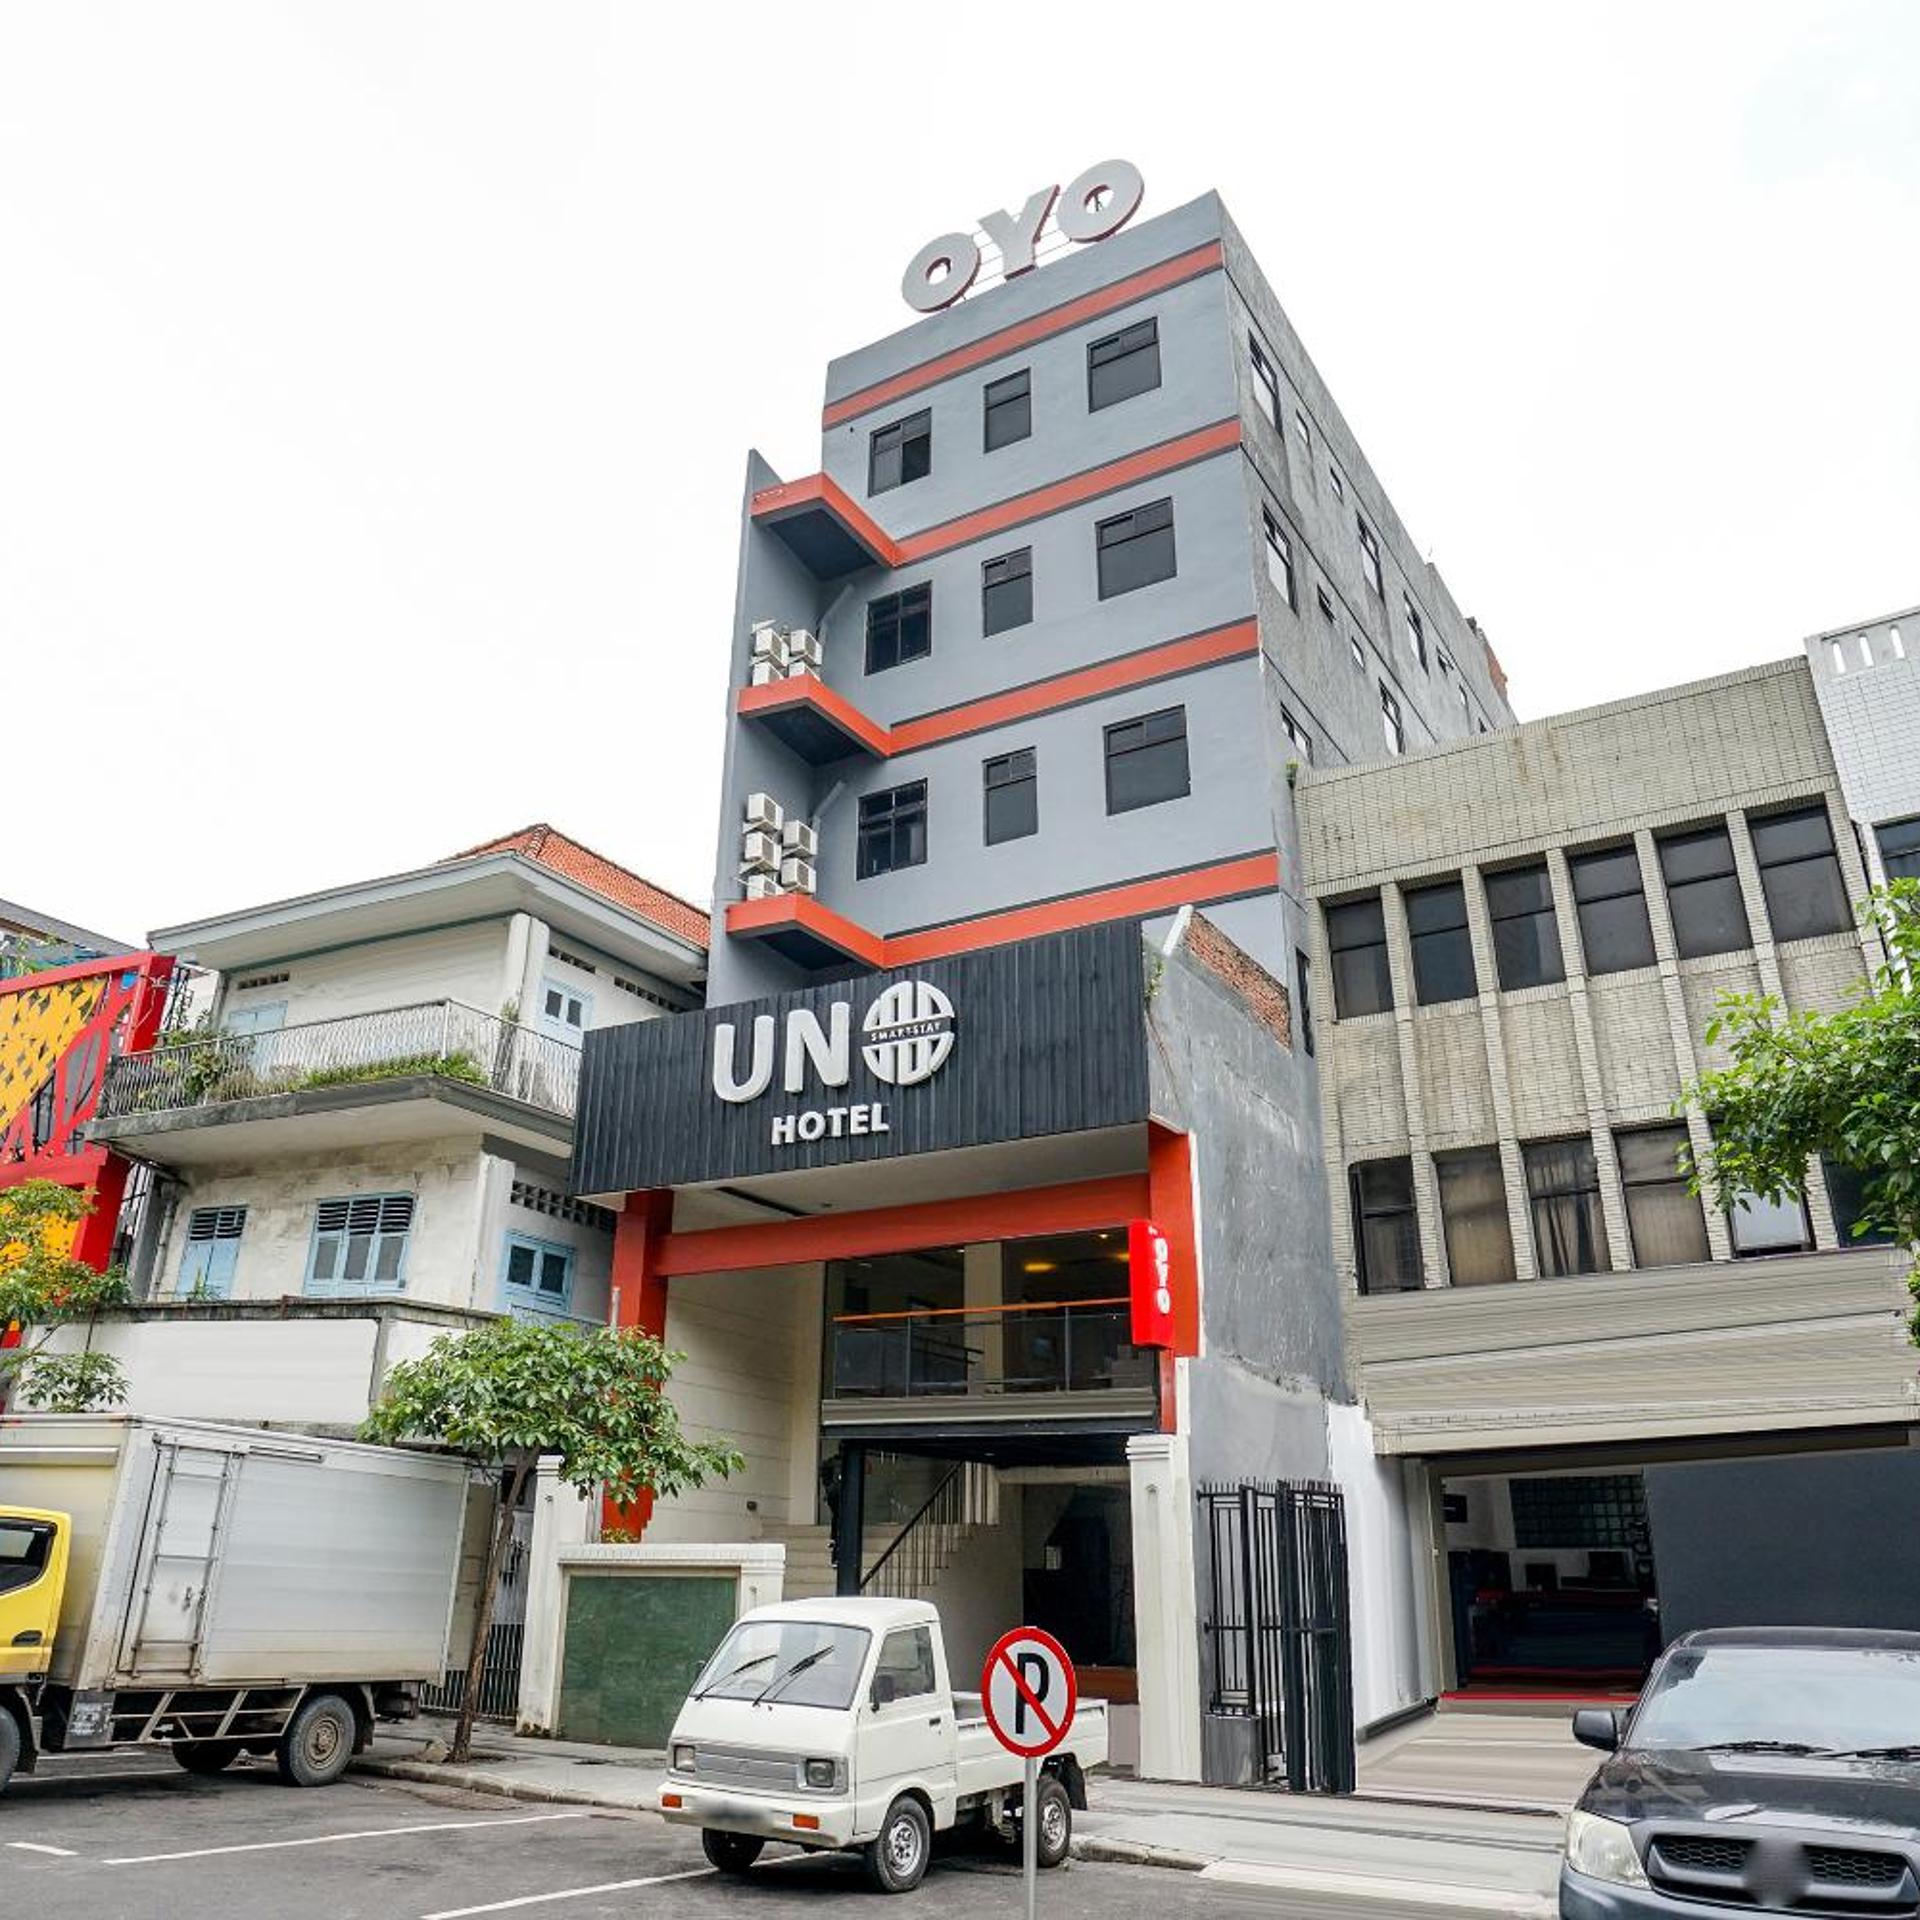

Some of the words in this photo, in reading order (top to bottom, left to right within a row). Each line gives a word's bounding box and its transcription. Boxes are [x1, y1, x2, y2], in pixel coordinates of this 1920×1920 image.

[901, 158, 1145, 313] OYO
[771, 1103, 890, 1146] HOTEL
[1015, 1652, 1050, 1735] P
